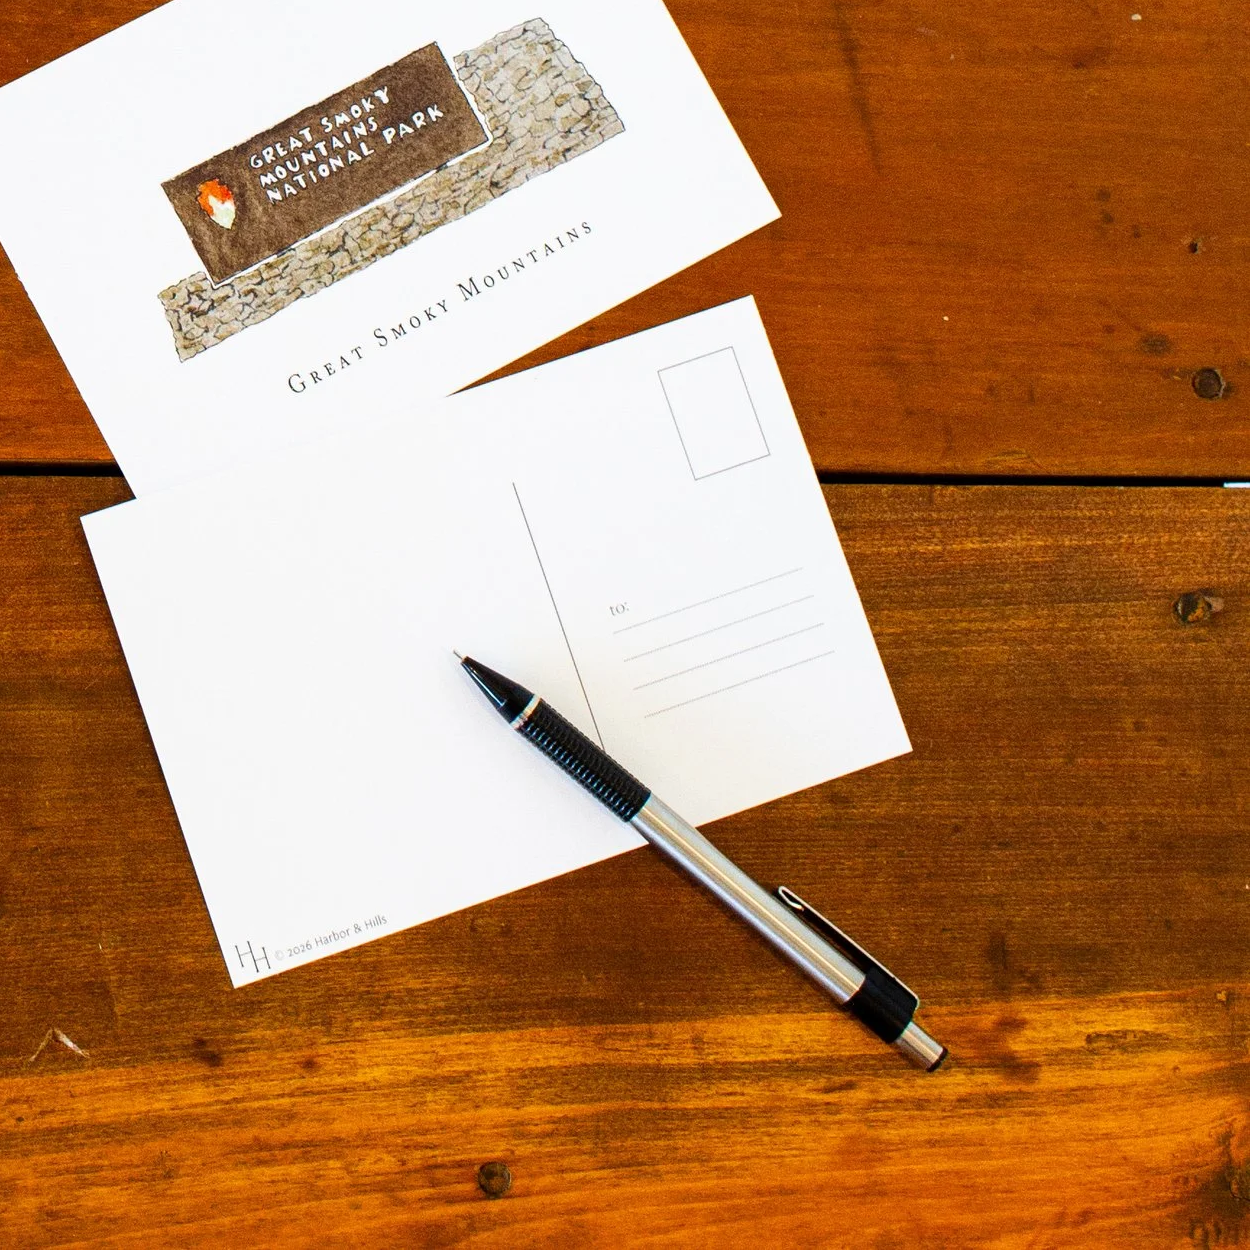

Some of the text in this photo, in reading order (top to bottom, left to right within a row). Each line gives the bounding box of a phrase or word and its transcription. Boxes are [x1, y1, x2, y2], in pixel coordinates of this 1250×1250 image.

[250, 85, 390, 169] GREAT SMOKY
[259, 116, 378, 189] MOUNTAINS
[266, 104, 445, 205] NATIONAL PARK
[287, 221, 593, 394] GREAT SMOKY MOUNTAINS
[608, 601, 630, 617] to:
[287, 940, 313, 958] 2026
[315, 927, 351, 948] Harbor
[352, 923, 363, 935] &
[364, 914, 388, 931] Hills
